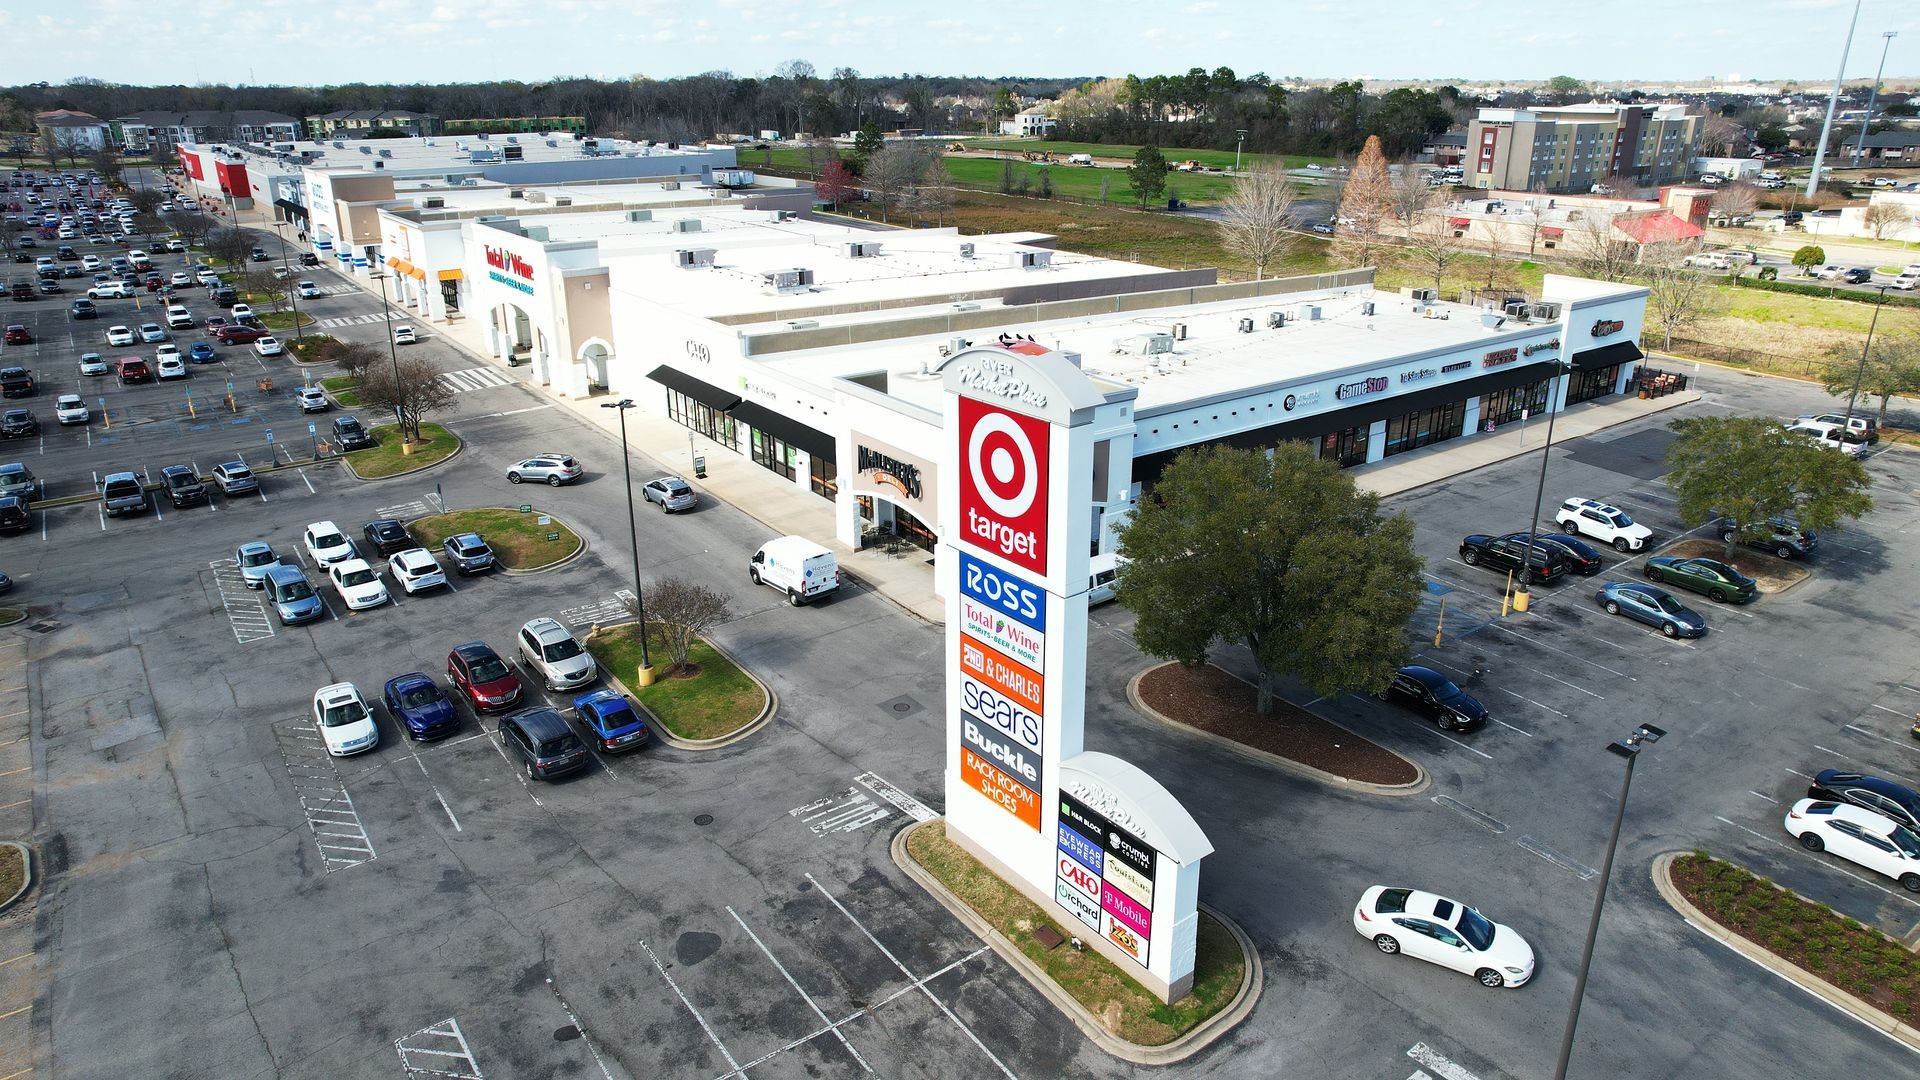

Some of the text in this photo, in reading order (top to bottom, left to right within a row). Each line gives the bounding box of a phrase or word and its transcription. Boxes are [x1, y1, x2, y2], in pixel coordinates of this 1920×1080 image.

[484, 244, 534, 281] Total Wine
[981, 357, 1014, 376] RIVER
[1338, 377, 1389, 400] GameStop
[968, 507, 1037, 559] target
[967, 563, 1037, 619] ROSS
[965, 603, 1040, 653] Total Wine
[1017, 648, 1036, 663] MORE
[964, 643, 1040, 704] 2ND & CHARLES
[964, 681, 1039, 746] sears
[964, 720, 1037, 782] Buckle
[967, 752, 1033, 807] RACK ROOM
[982, 779, 1017, 814] SHOES
[1060, 828, 1101, 861] EYEWEAR
[1083, 818, 1102, 836] BLOCK
[1060, 836, 1101, 869] EXPRESS
[1121, 841, 1150, 865] crumbl
[1122, 849, 1148, 869] cookies
[1060, 859, 1099, 896] CATO
[1114, 896, 1148, 929] Mobile
